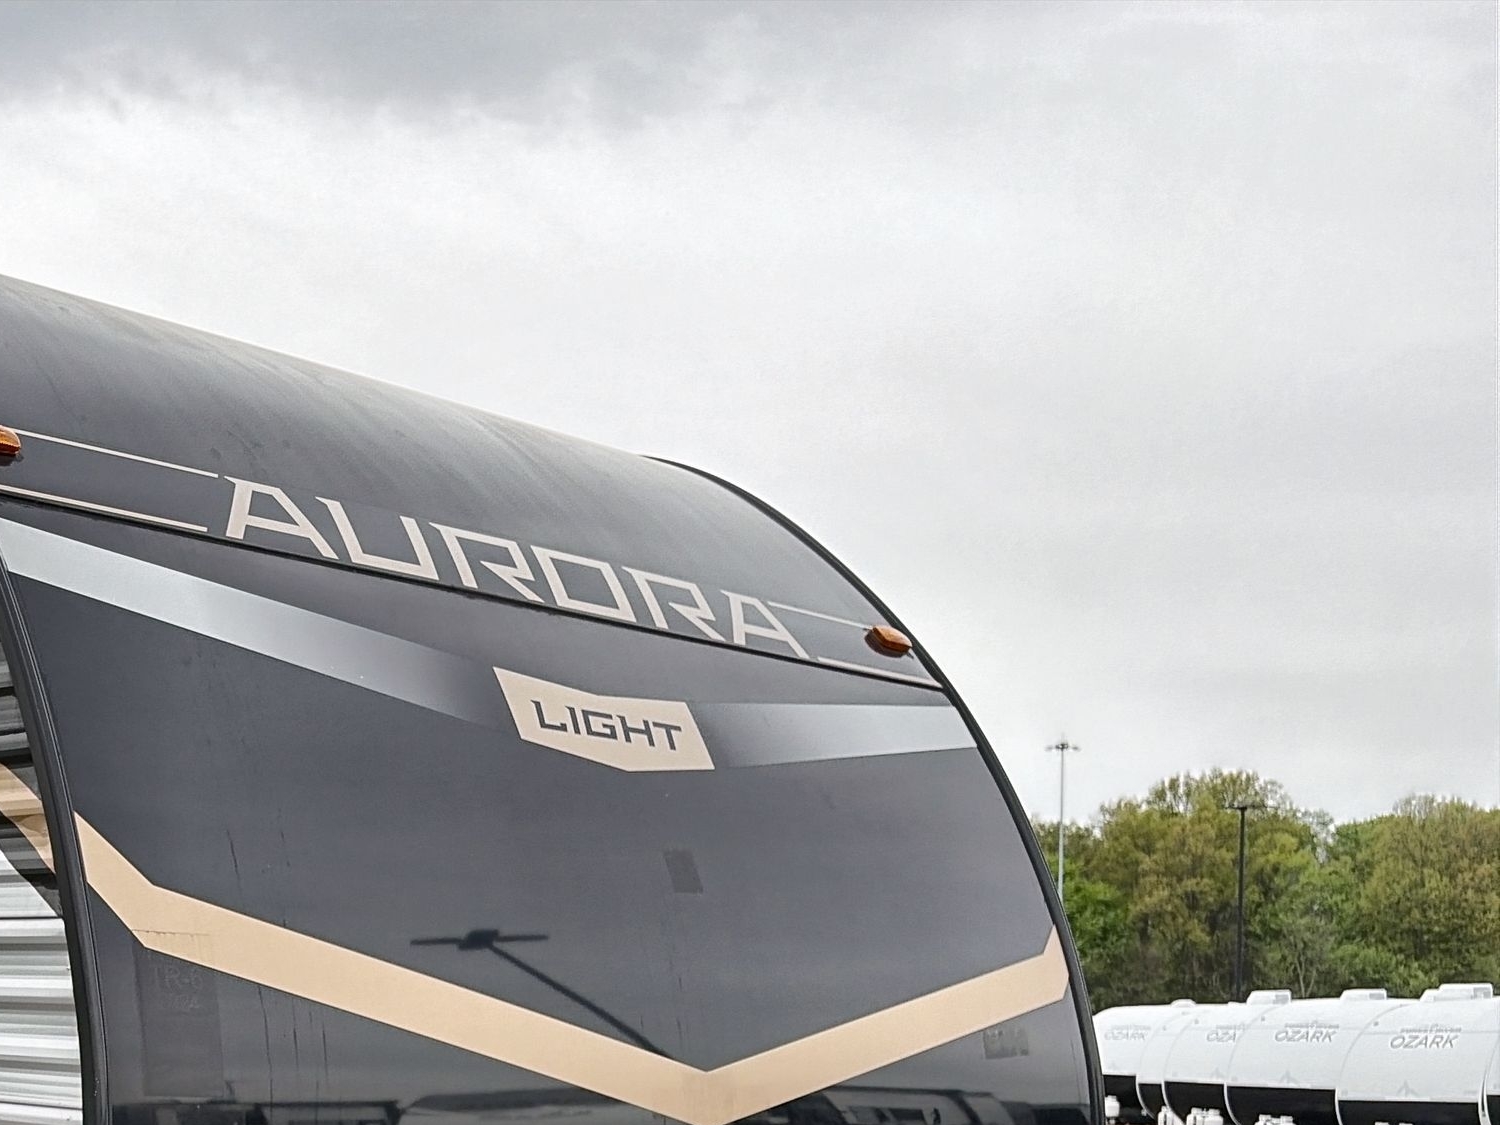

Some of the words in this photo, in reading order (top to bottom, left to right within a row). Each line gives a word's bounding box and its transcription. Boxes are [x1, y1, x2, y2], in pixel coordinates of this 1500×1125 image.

[224, 475, 810, 660] AURORA
[531, 699, 682, 750] LIGHT
[1275, 1030, 1338, 1043] OZARK
[1390, 1034, 1459, 1049] OZARK
